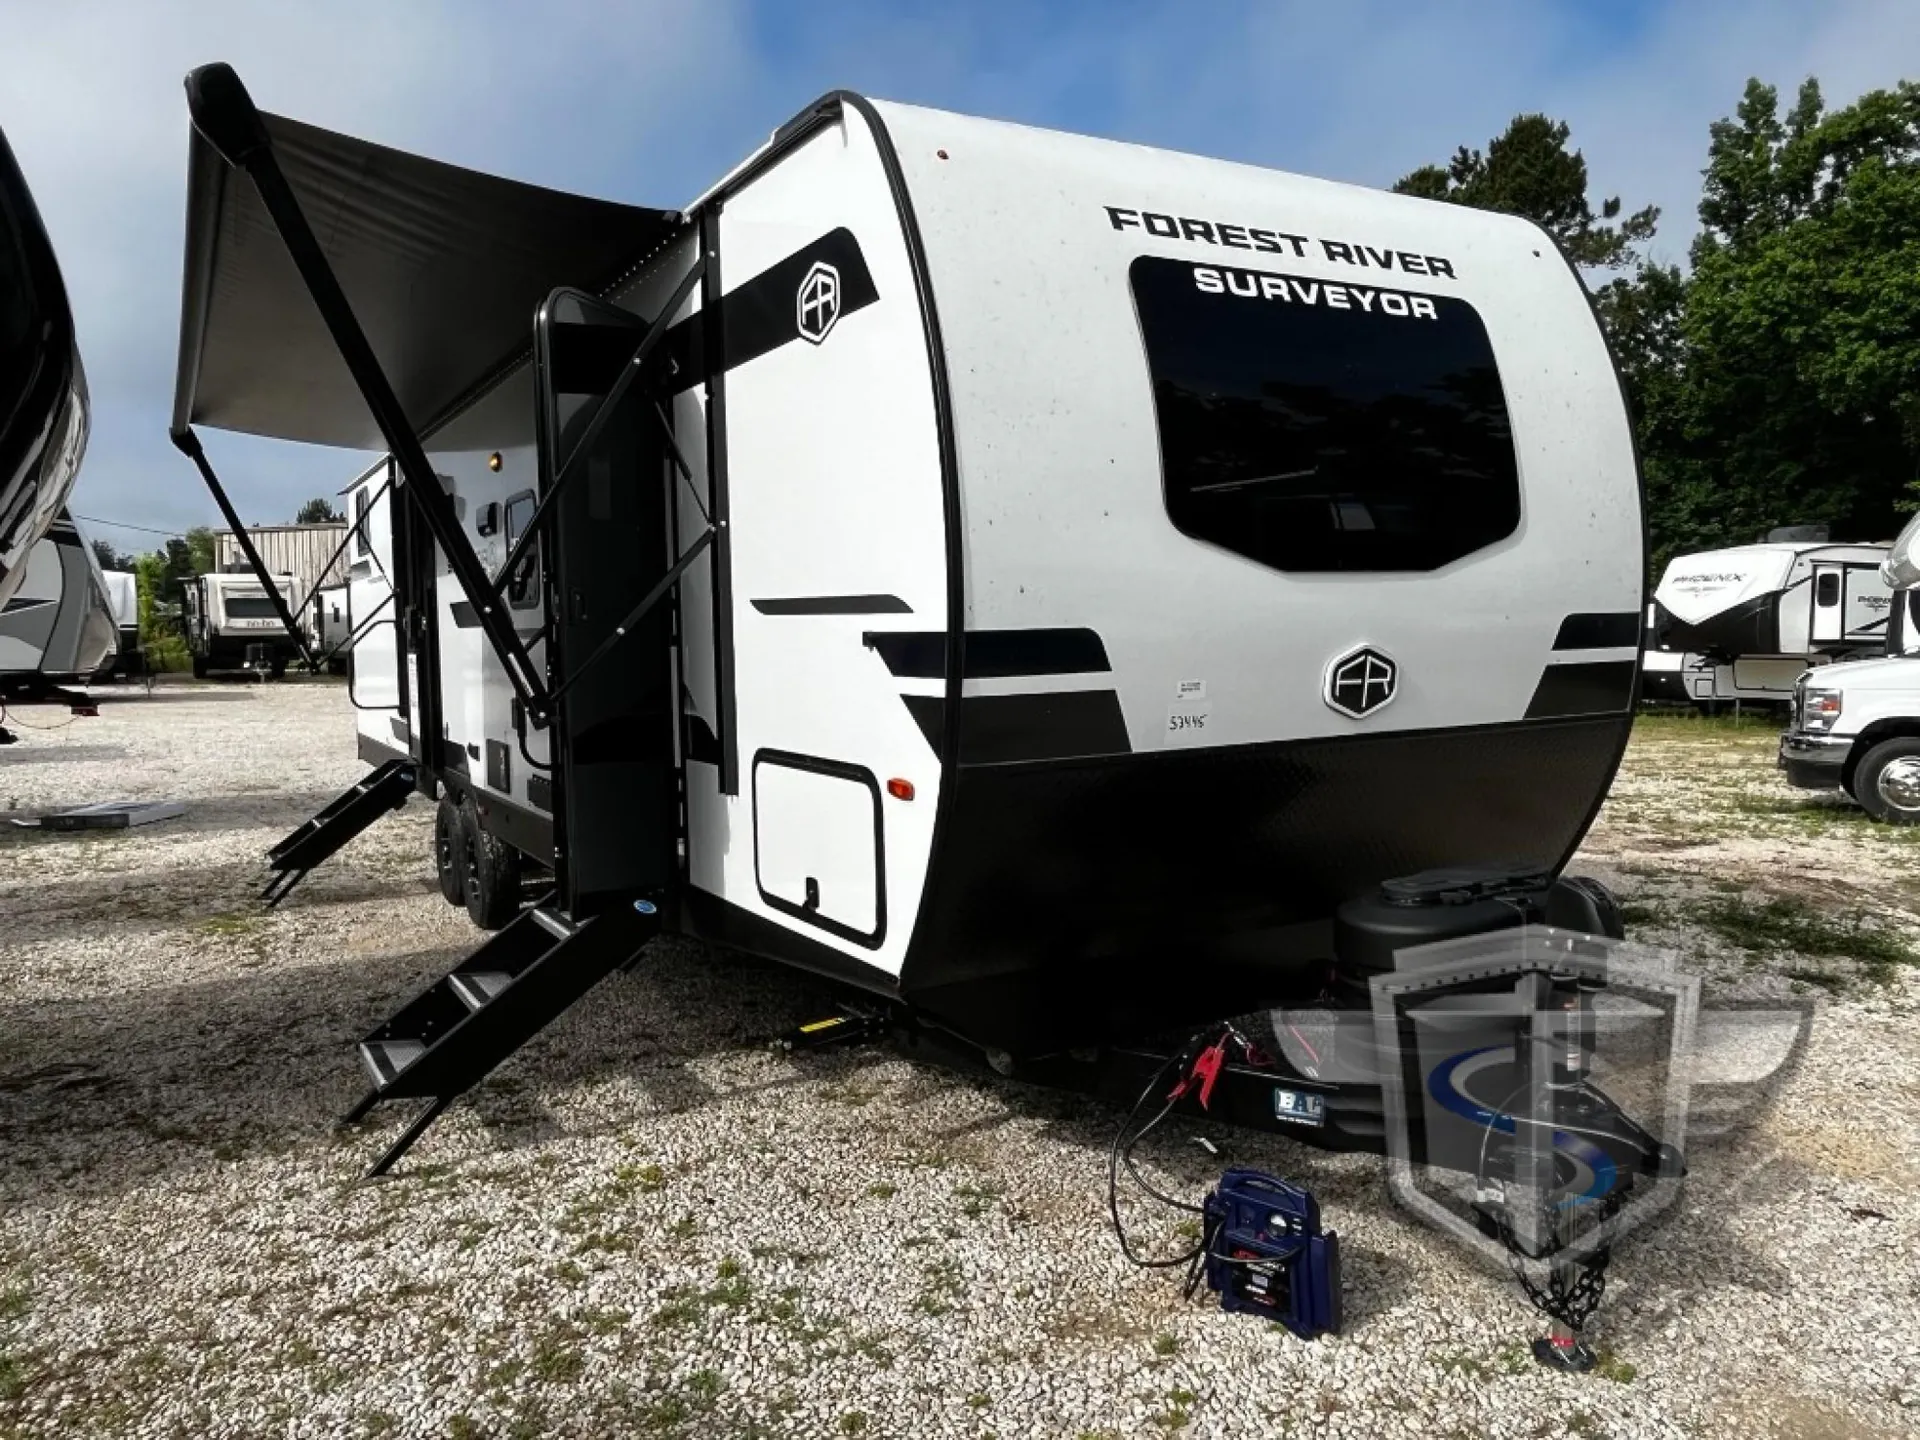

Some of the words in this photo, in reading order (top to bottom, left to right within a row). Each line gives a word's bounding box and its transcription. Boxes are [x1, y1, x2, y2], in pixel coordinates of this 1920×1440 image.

[1104, 206, 1308, 257] FOREST
[1320, 239, 1457, 280] RIVER
[1193, 268, 1437, 320] SURVEYOR
